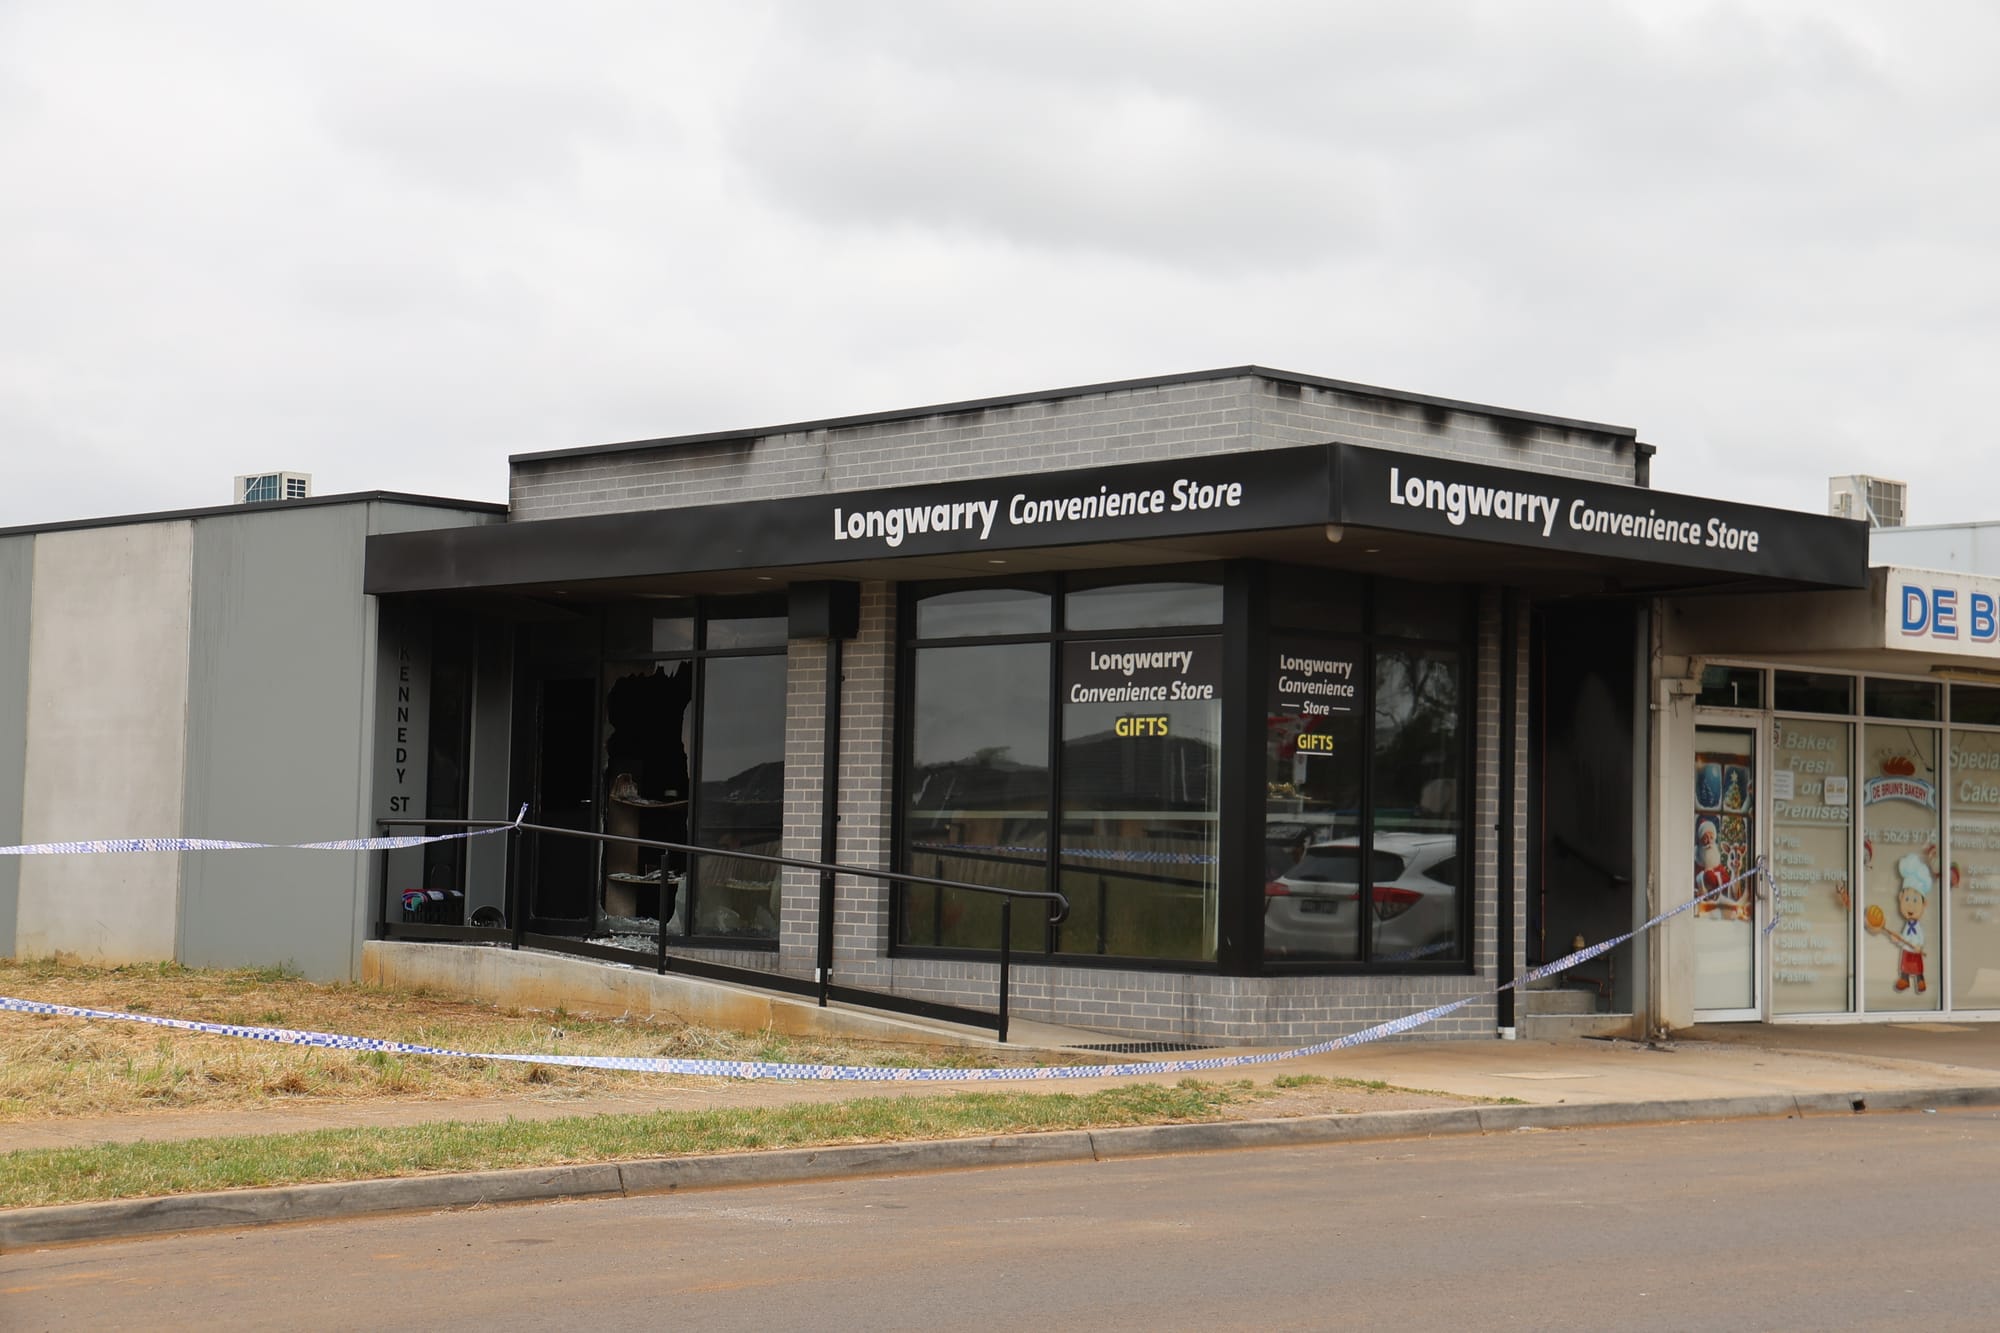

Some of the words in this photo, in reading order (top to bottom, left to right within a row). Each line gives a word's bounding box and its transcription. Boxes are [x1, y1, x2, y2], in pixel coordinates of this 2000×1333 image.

[833, 499, 999, 547] Longwarry
[1009, 485, 1164, 526] Convenience
[1170, 478, 1243, 513] Store
[1389, 467, 1560, 536] Longwarry
[1568, 498, 1702, 546] Convenience
[1706, 517, 1760, 552] Store
[1901, 585, 1959, 640] DE
[1090, 650, 1194, 677] Longwarry
[1280, 654, 1353, 680] Longwarry
[1070, 681, 1168, 703] Convenience
[1169, 680, 1214, 702] Store
[1278, 676, 1355, 698] Convenience
[396, 645, 411, 784] KENNEDY
[1303, 700, 1330, 716] Store
[1115, 716, 1169, 737] GIFTS
[1297, 733, 1334, 751] GIFTS
[1786, 731, 1838, 752] Baked
[1789, 753, 1835, 774] Fresh
[1801, 781, 1824, 796] on
[1904, 783, 1927, 802] BAKERY
[389, 796, 411, 813] ST
[1774, 800, 1850, 820] Premises
